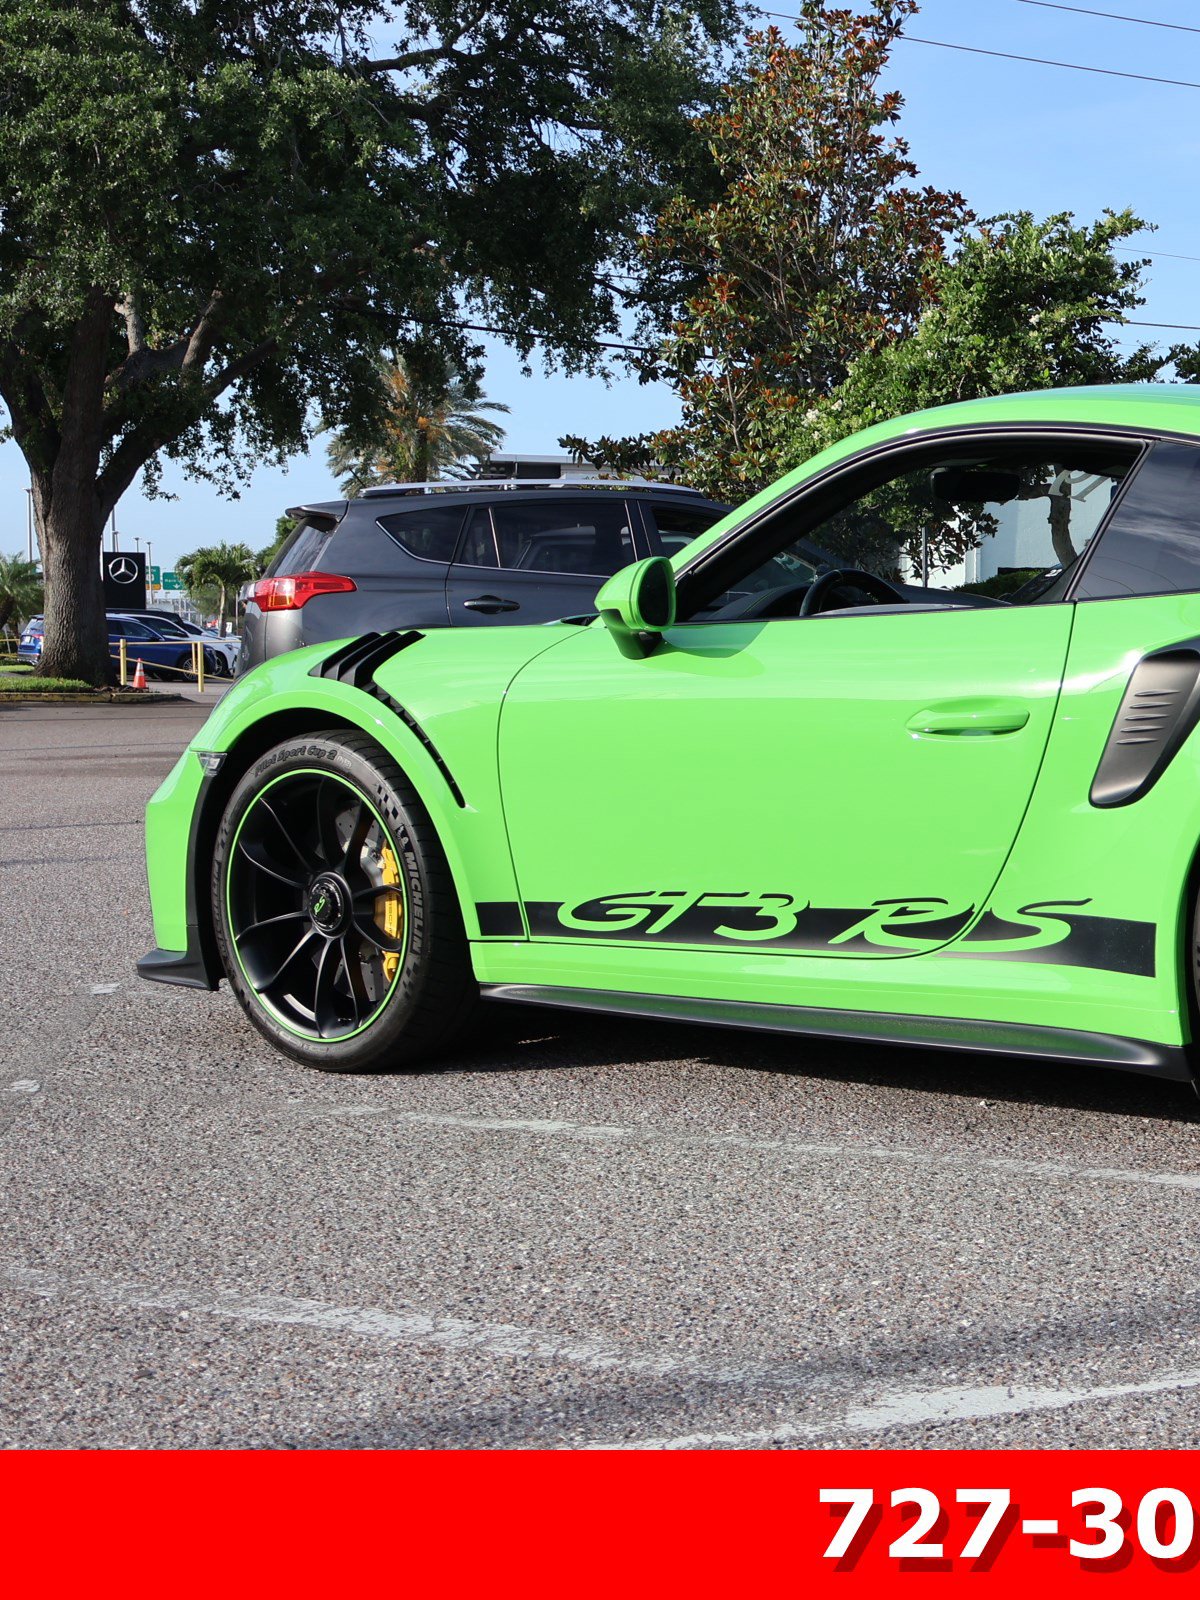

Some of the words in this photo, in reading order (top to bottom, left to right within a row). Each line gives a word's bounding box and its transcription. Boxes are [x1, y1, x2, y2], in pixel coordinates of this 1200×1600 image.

[254, 754, 277, 778] Pilot
[277, 745, 307, 762] Sport
[307, 745, 326, 759] Cup
[327, 749, 338, 761] 2
[404, 851, 423, 953] MICHELIN
[557, 890, 809, 941] GT3
[827, 897, 1093, 953] RS
